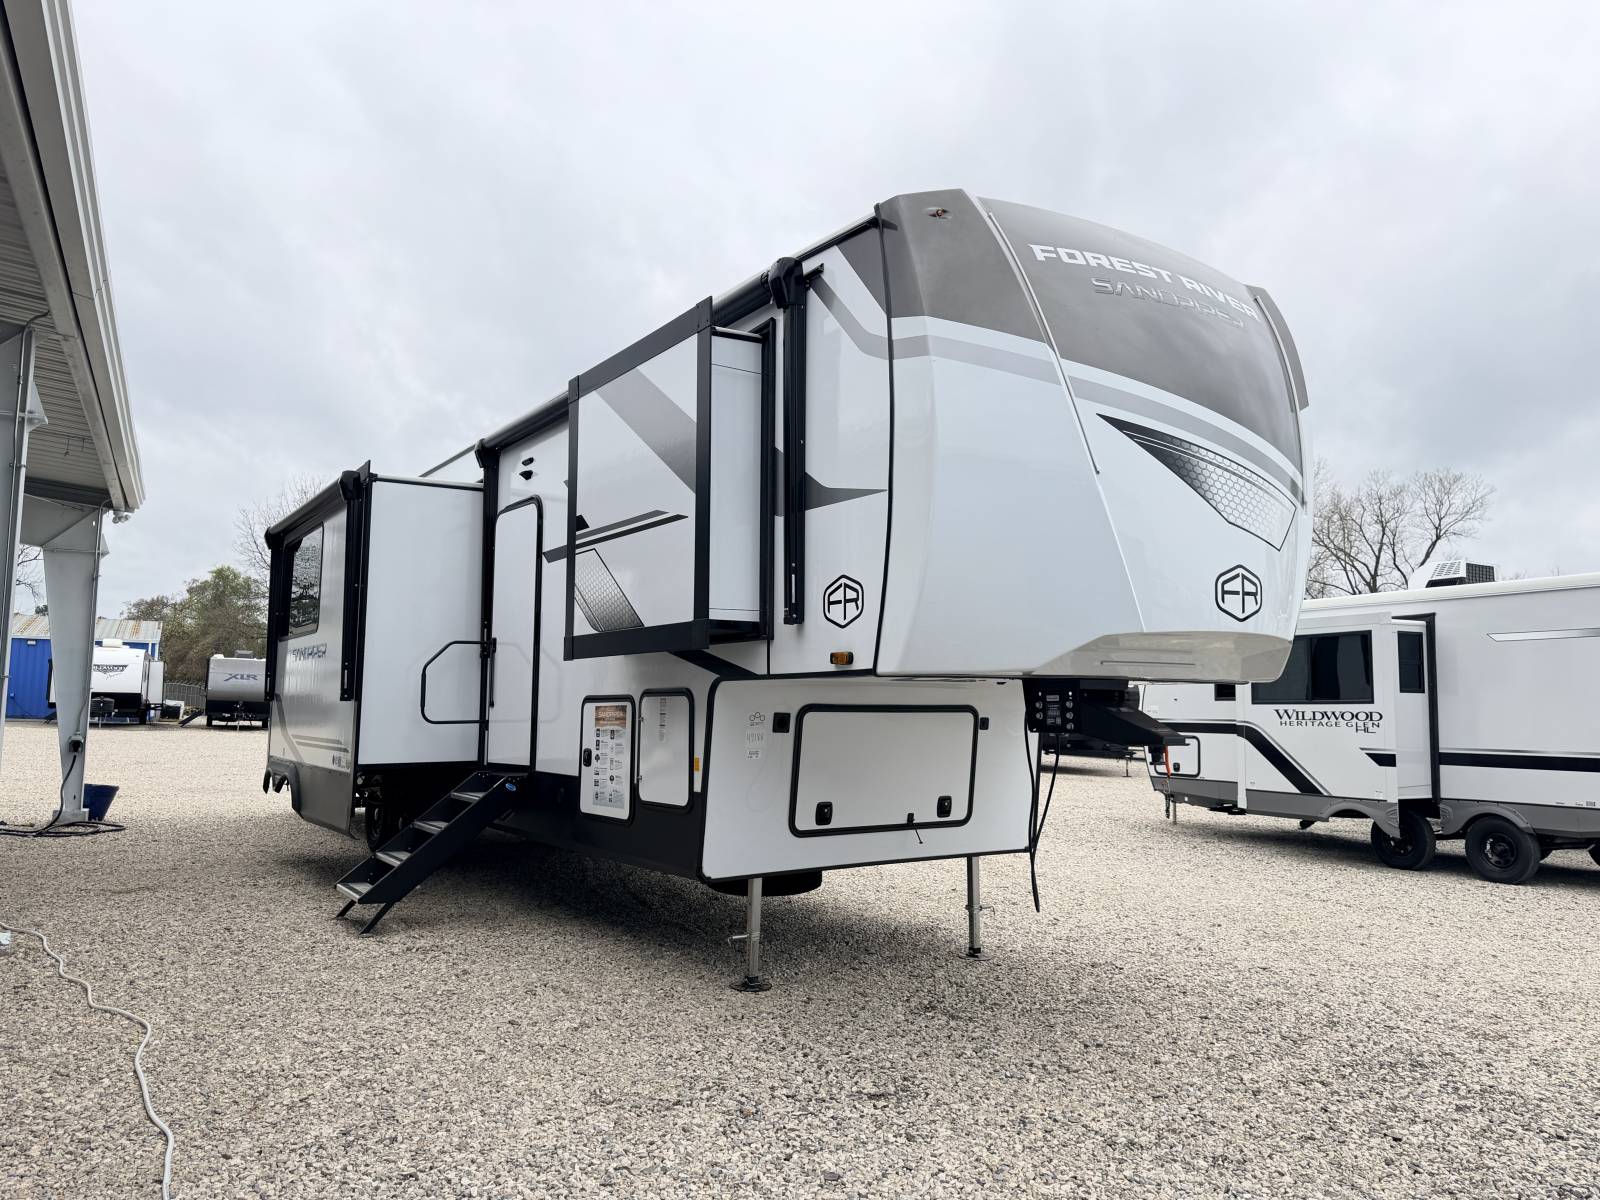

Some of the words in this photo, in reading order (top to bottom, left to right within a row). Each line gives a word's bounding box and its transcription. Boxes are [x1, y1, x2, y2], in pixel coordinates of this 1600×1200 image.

[1028, 243, 1173, 284] FOREST
[1177, 274, 1262, 323] RIVER
[223, 673, 258, 682] XLR
[1273, 708, 1384, 722] WILDWOOD
[1279, 720, 1341, 728] HERITAGE
[1345, 721, 1380, 729] GLEN
